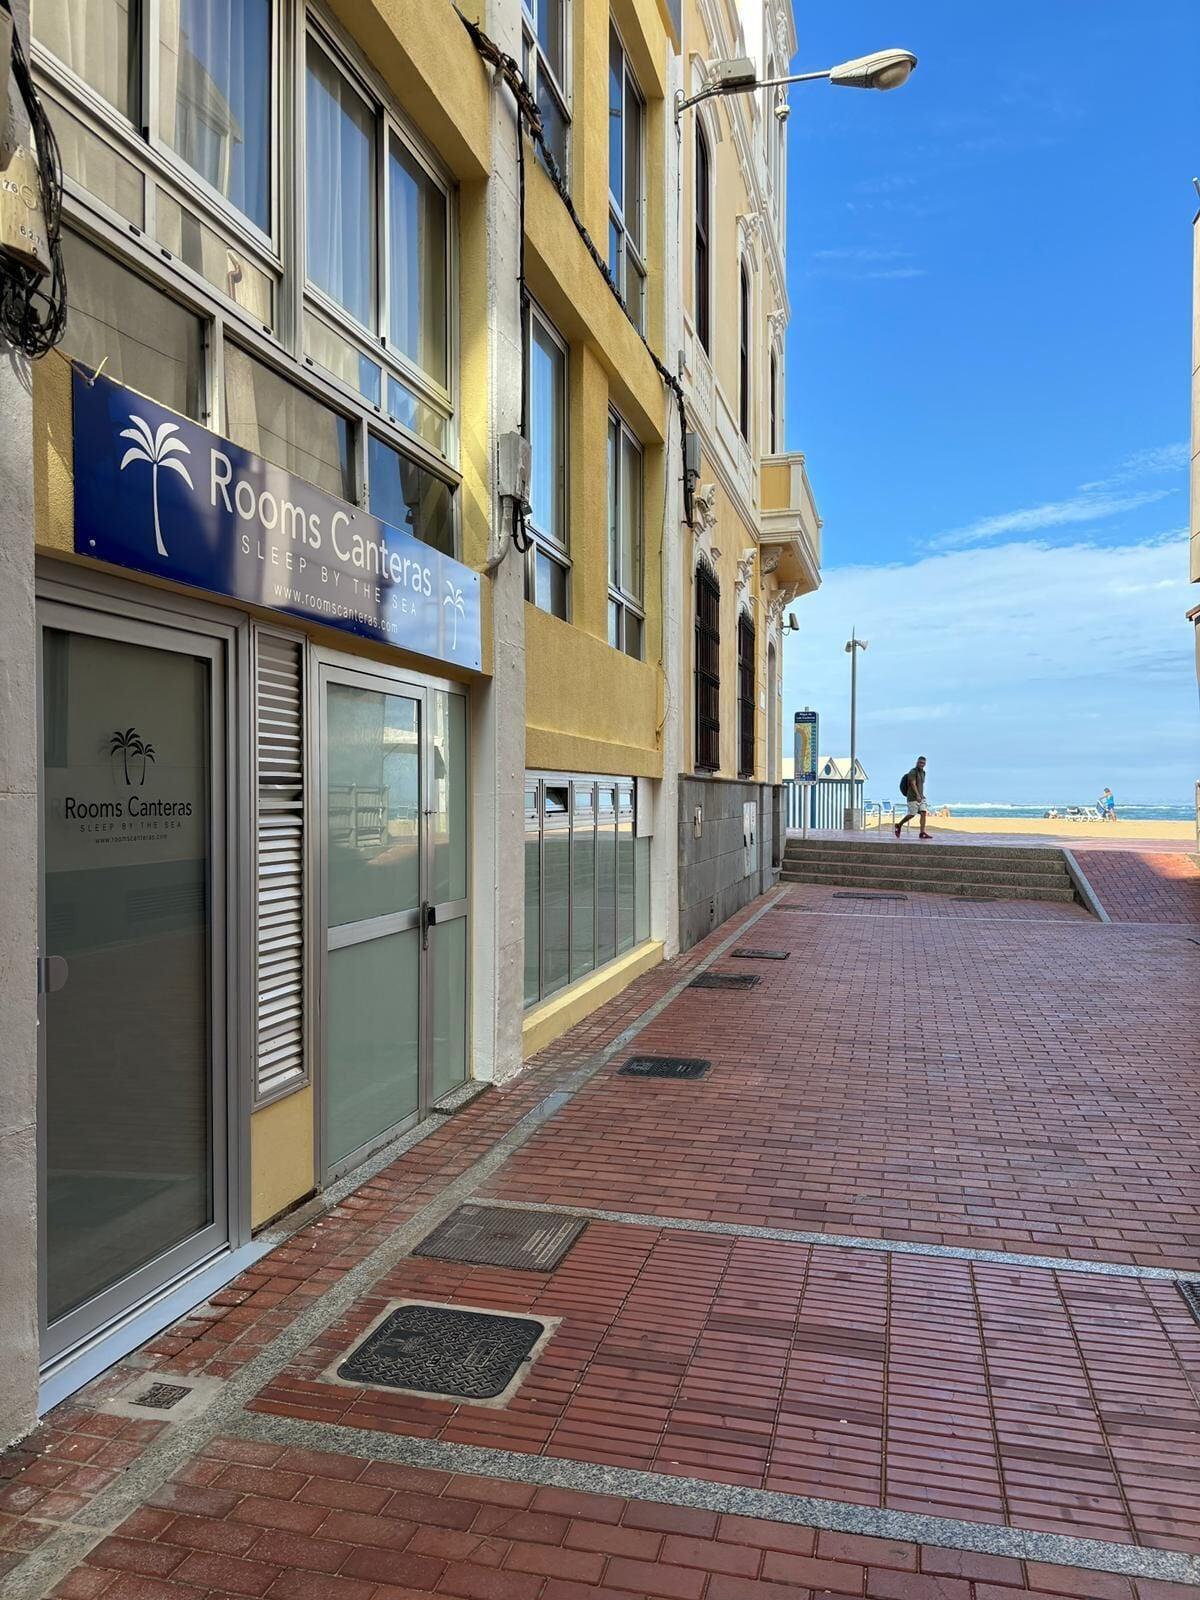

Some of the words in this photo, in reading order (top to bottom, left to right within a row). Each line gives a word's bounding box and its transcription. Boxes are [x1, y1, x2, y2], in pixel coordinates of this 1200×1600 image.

[210, 447, 322, 550] Rooms
[331, 511, 433, 597] Canteras
[241, 534, 308, 573] SLEEP
[321, 556, 342, 587] BY
[353, 577, 382, 604] THE
[392, 593, 418, 617] SEA
[273, 582, 399, 635] www.roomscanteras.com
[65, 797, 122, 819] Rooms
[128, 796, 192, 817] Canteras
[79, 823, 115, 833] SLEEP
[121, 822, 133, 831] BY
[140, 821, 158, 830] THE
[164, 820, 182, 829] SEA
